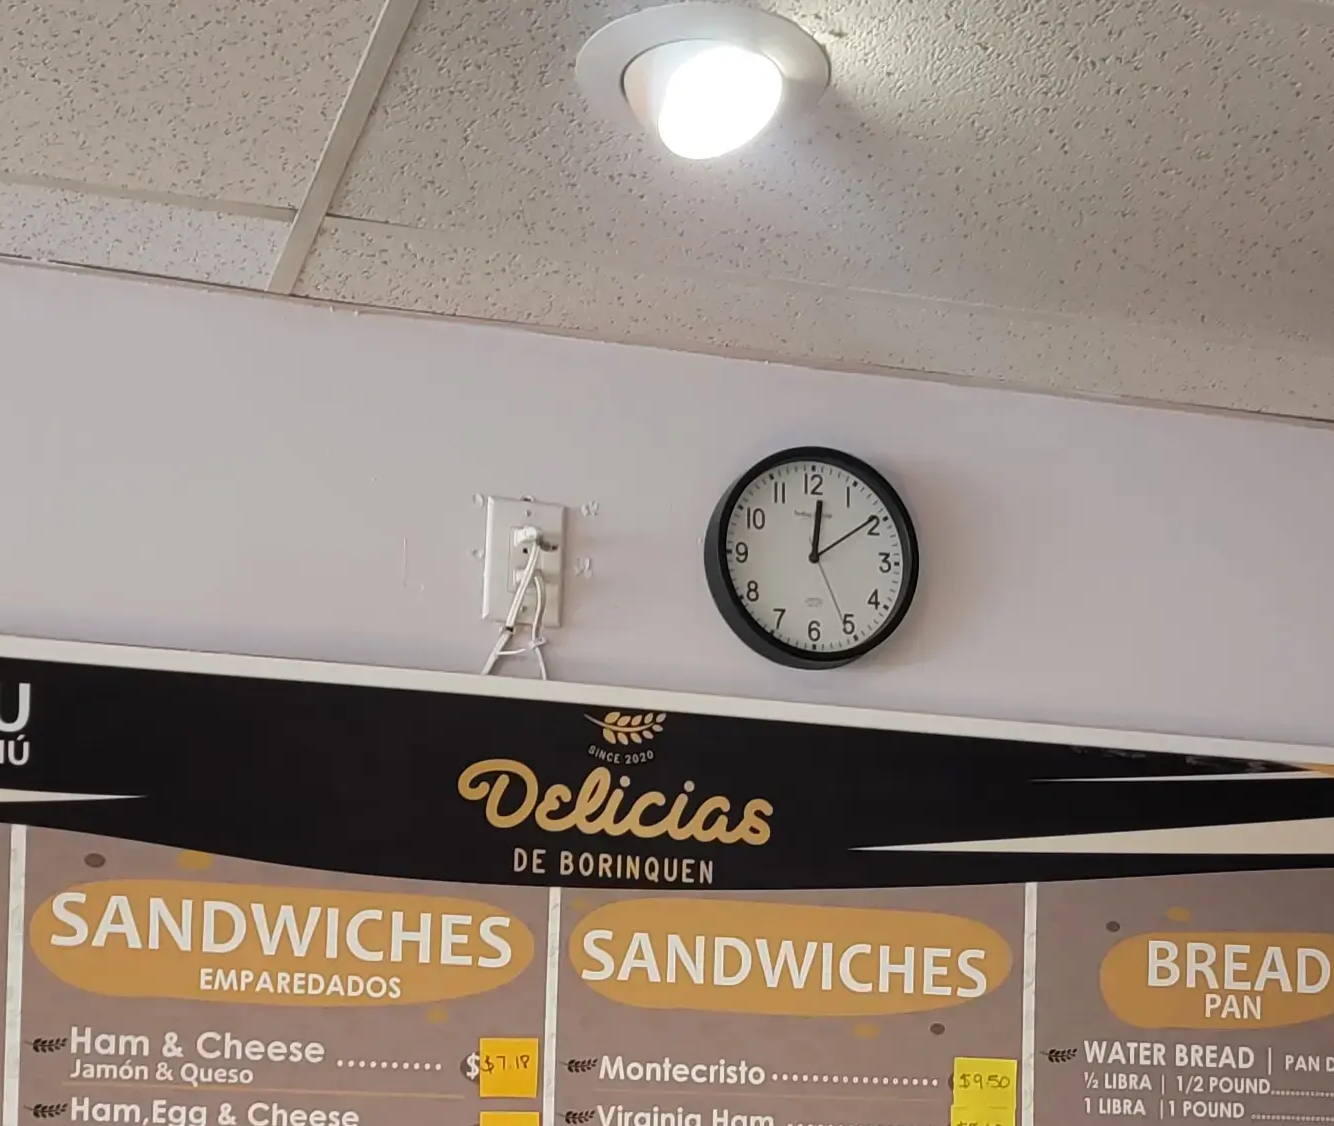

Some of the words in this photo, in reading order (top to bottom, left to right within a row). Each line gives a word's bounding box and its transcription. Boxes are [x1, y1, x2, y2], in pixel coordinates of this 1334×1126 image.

[774, 482, 785, 504] 11
[804, 473, 823, 495] 12
[747, 507, 765, 529] 10
[736, 542, 748, 563] 9
[879, 552, 891, 573] 3
[746, 581, 759, 601] 8
[867, 589, 880, 609] 4
[773, 608, 786, 629] 7
[842, 614, 855, 635] 5
[808, 621, 820, 641] 6
[588, 745, 620, 764] SINCE
[625, 750, 654, 764] 2020
[458, 758, 773, 845] Delicias
[514, 848, 546, 874] DE
[560, 851, 713, 884] BORINQUEN
[51, 892, 511, 968] SANDWICHES
[581, 930, 986, 998] SANDWICHES
[1148, 940, 1330, 993] BREAD
[200, 968, 401, 999] EMPAREDADOS
[1206, 994, 1261, 1020] PAN
[71, 1026, 149, 1056] Ham
[162, 1032, 184, 1057] &
[197, 1032, 325, 1063] Cheese
[1084, 1040, 1166, 1066] WATER
[1176, 1044, 1254, 1069] BREAD
[1285, 1055, 1320, 1071] PAN
[70, 1059, 148, 1080] Jamón
[156, 1062, 173, 1081] &
[180, 1063, 253, 1087] Queso
[599, 1055, 765, 1085] Montecristo
[959, 1073, 1010, 1090] $9.50
[1105, 1073, 1152, 1090] LIBRA
[1177, 1076, 1204, 1094] 1/2
[218, 1103, 236, 1125] &
[1099, 1098, 1146, 1115] LIBRA
[1183, 1101, 1244, 1118] POUND
